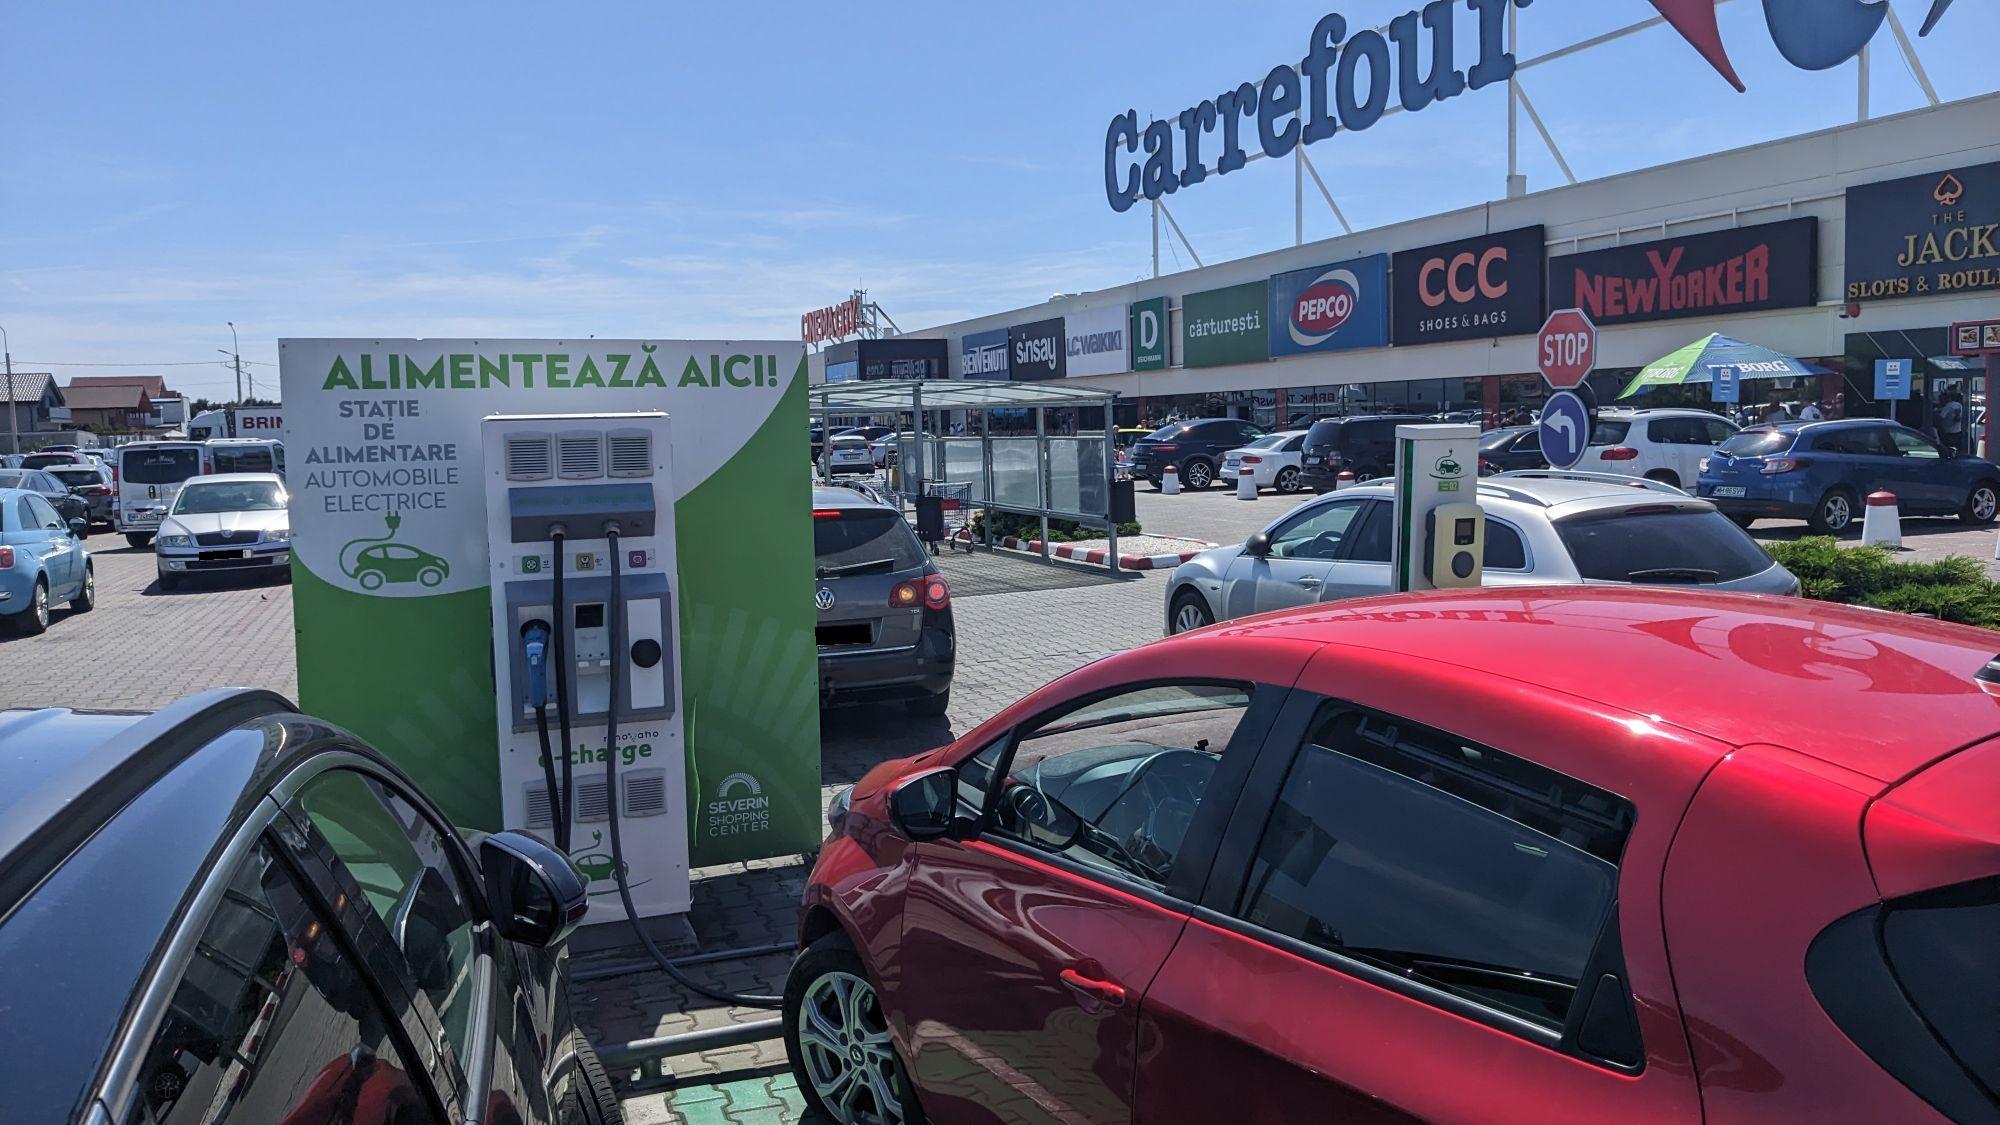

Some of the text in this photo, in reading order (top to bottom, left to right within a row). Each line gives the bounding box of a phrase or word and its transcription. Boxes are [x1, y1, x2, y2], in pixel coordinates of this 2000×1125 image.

[1105, 0, 1534, 213] Carrefour
[1932, 210, 1965, 225] THE
[1418, 246, 1508, 307] CCC
[1848, 277, 1910, 298] SLOTS
[1916, 275, 1930, 292] &
[1298, 294, 1348, 322] PEPCO
[1140, 310, 1158, 350] D
[1419, 310, 1507, 332] SHOES & BAGS
[963, 344, 1007, 375] BENVENUTI
[1016, 332, 1056, 371] sinsay
[1543, 332, 1589, 367] STOP
[322, 344, 778, 390] ALIMENTEAZĂ AICI!
[363, 423, 395, 441] DE
[305, 443, 457, 465] ALIMENTARE
[304, 467, 459, 489] AUTOMOBILE
[324, 492, 447, 513] ELECTRICE
[709, 796, 769, 815] SEVERIN
[709, 810, 769, 826] SHOPPING
[709, 820, 769, 837] CENTER
